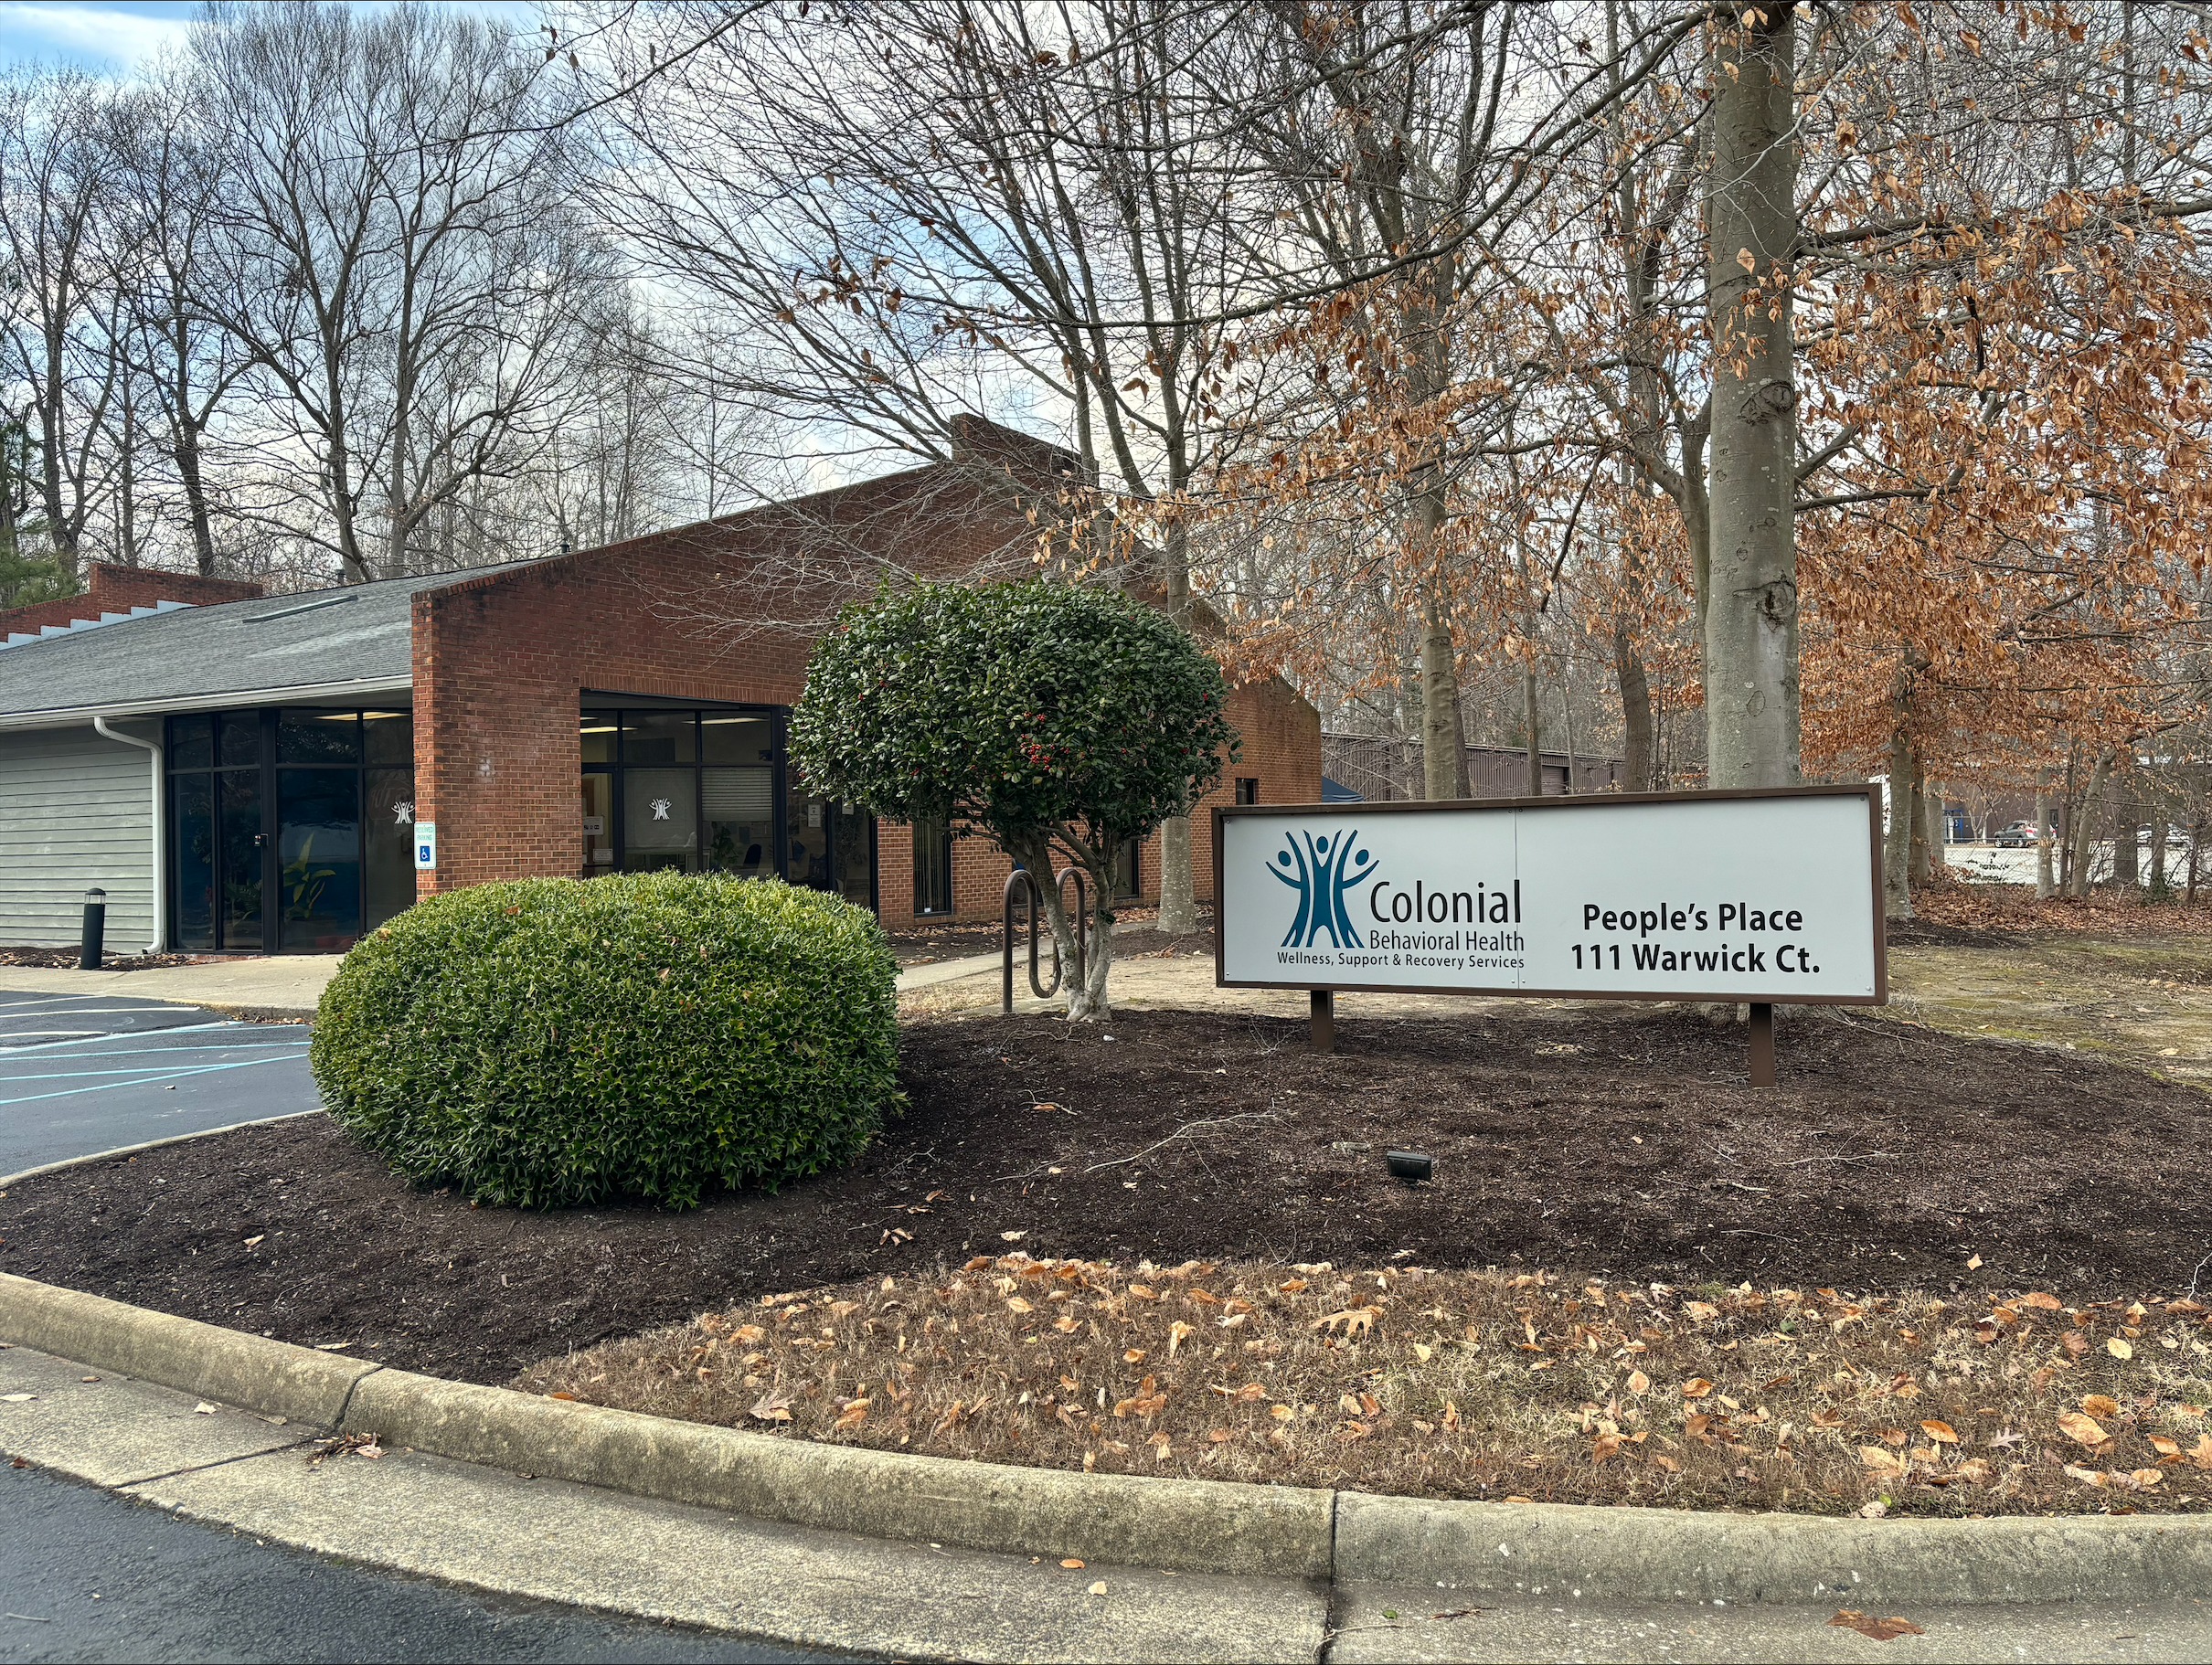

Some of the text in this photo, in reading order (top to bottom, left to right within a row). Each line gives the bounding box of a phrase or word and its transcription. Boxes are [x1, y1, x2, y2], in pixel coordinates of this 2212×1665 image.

[1370, 879, 1521, 923] Colonial
[1583, 902, 1803, 939] People's Place
[1370, 929, 1525, 951] Behavioral Health
[1277, 951, 1525, 970] Wellness, Support & Recovery Services
[1571, 943, 1820, 973] 111 Warwick Ct.
